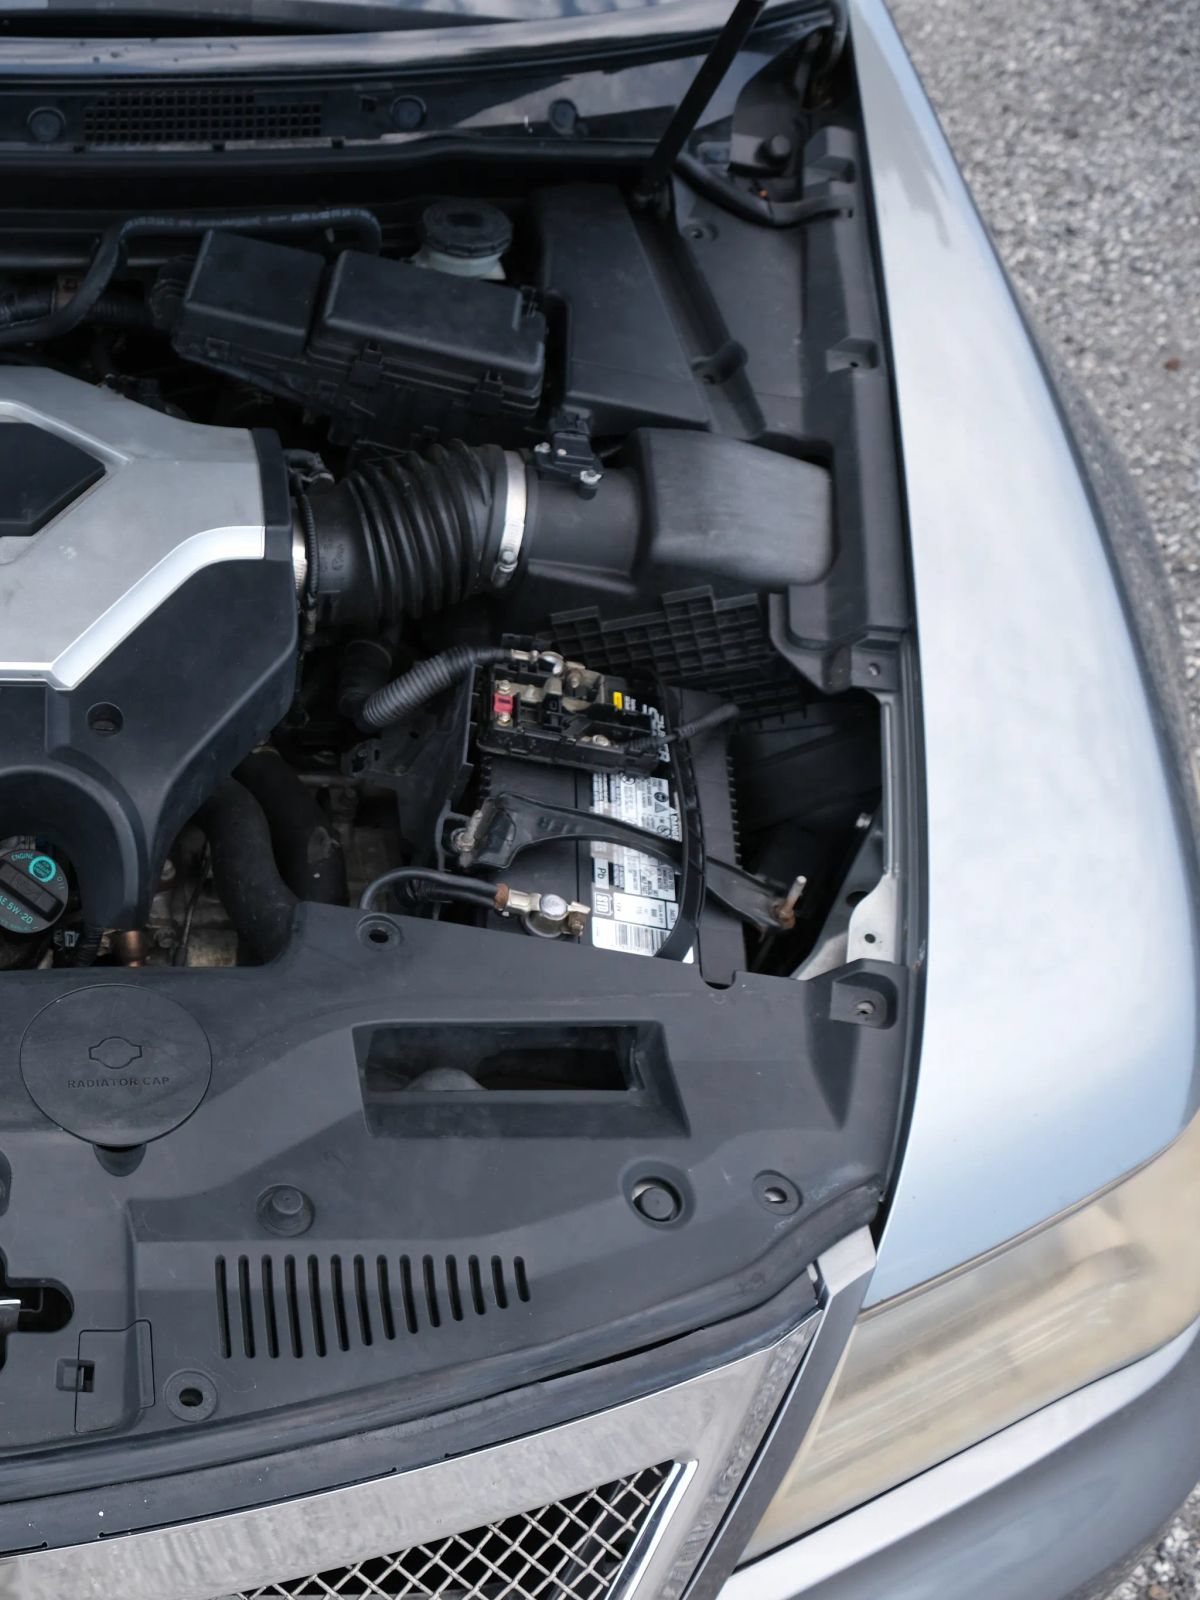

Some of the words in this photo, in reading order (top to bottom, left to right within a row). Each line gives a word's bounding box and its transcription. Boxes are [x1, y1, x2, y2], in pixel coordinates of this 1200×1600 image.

[597, 867, 607, 879] Pb
[7, 902, 33, 924] 5W-20
[67, 1078, 138, 1089] RADIATOR
[143, 1076, 170, 1086] CAP
